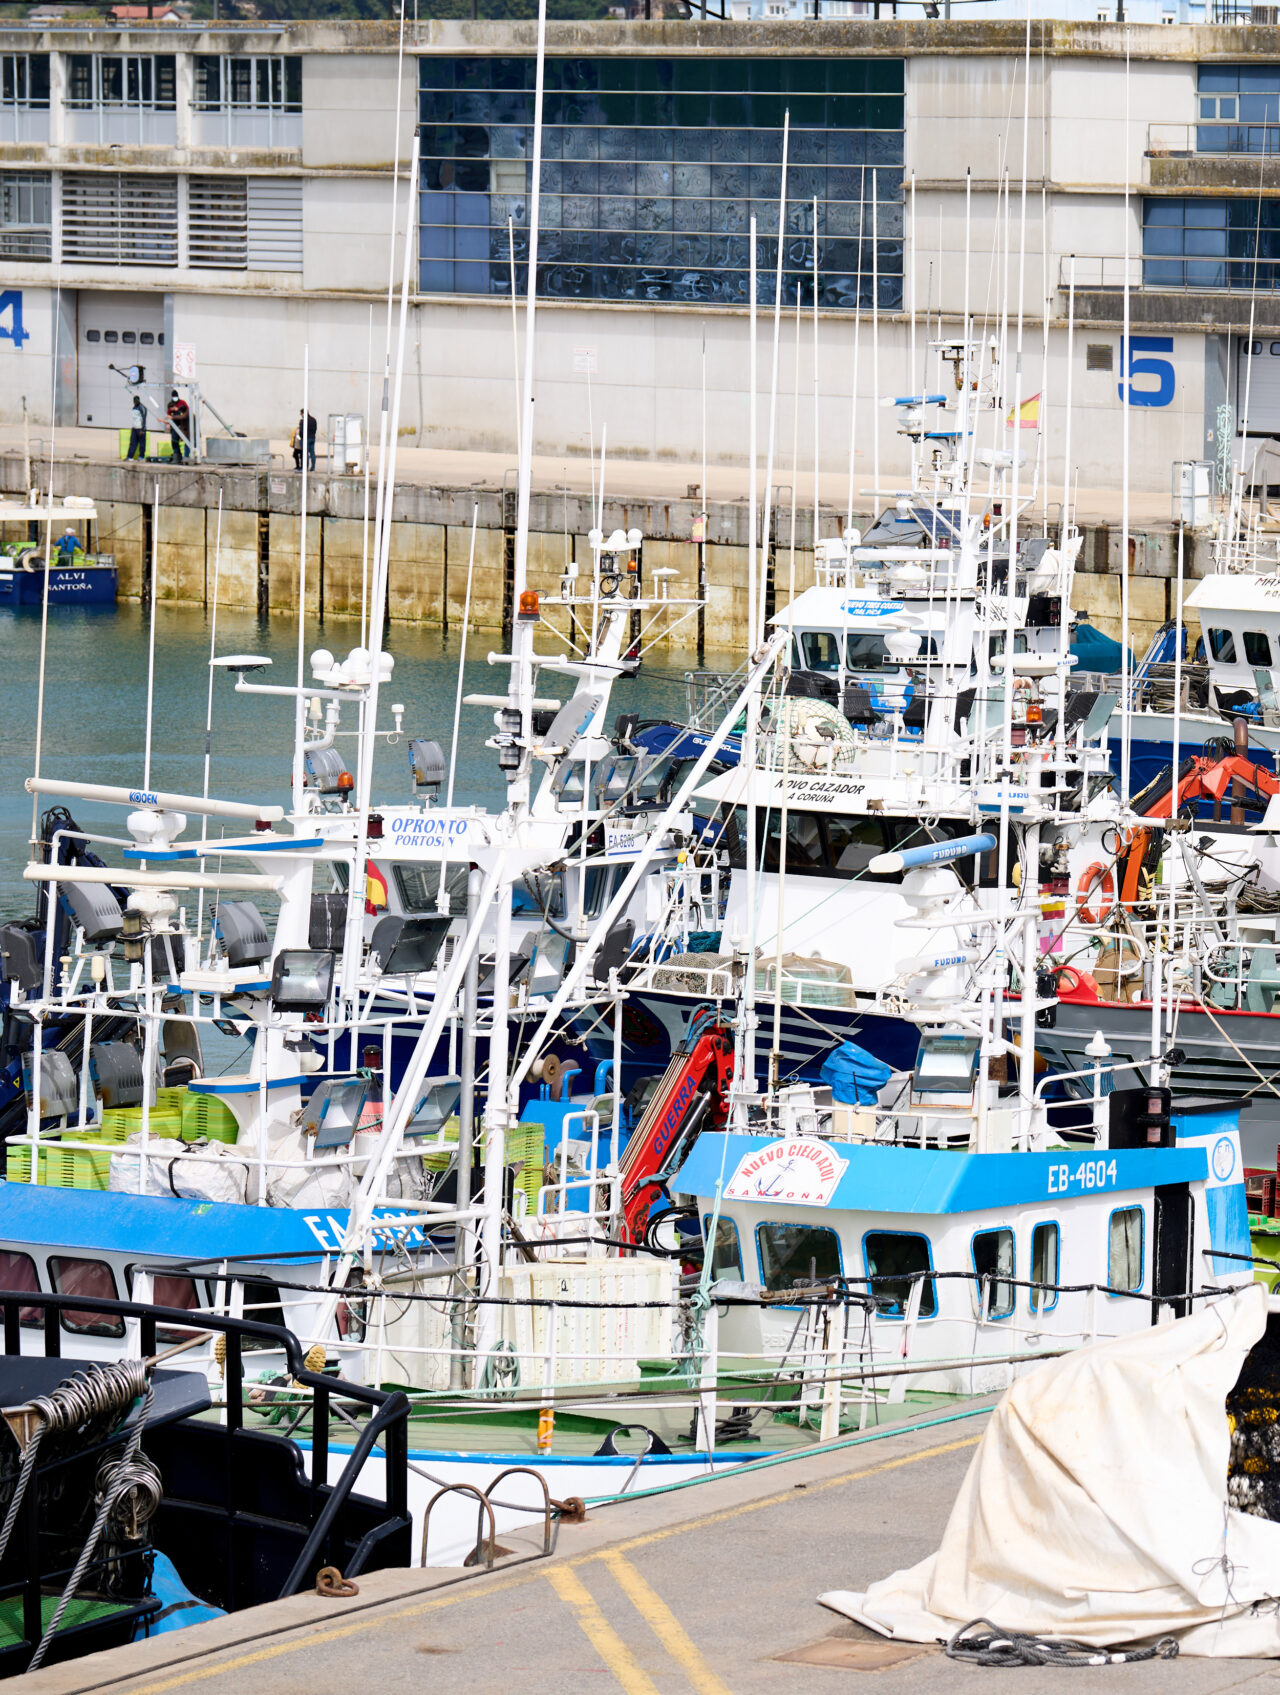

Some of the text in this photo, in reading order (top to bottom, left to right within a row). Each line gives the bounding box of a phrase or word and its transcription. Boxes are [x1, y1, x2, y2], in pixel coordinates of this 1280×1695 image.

[0, 290, 30, 350] 4
[1119, 336, 1176, 407] 5
[57, 572, 85, 580] ALVI
[810, 782, 865, 795] CAZADOR
[129, 792, 158, 805] KODEN
[788, 793, 835, 803] A CORUÑA
[392, 818, 467, 834] OPRONTO
[933, 845, 968, 860] FURUNO
[935, 955, 966, 967] FURUNO
[653, 1075, 696, 1155] GUERRA
[741, 1147, 784, 1179] NUEVO
[788, 1144, 818, 1162] CIELO
[1048, 1159, 1117, 1193] EB-4604
